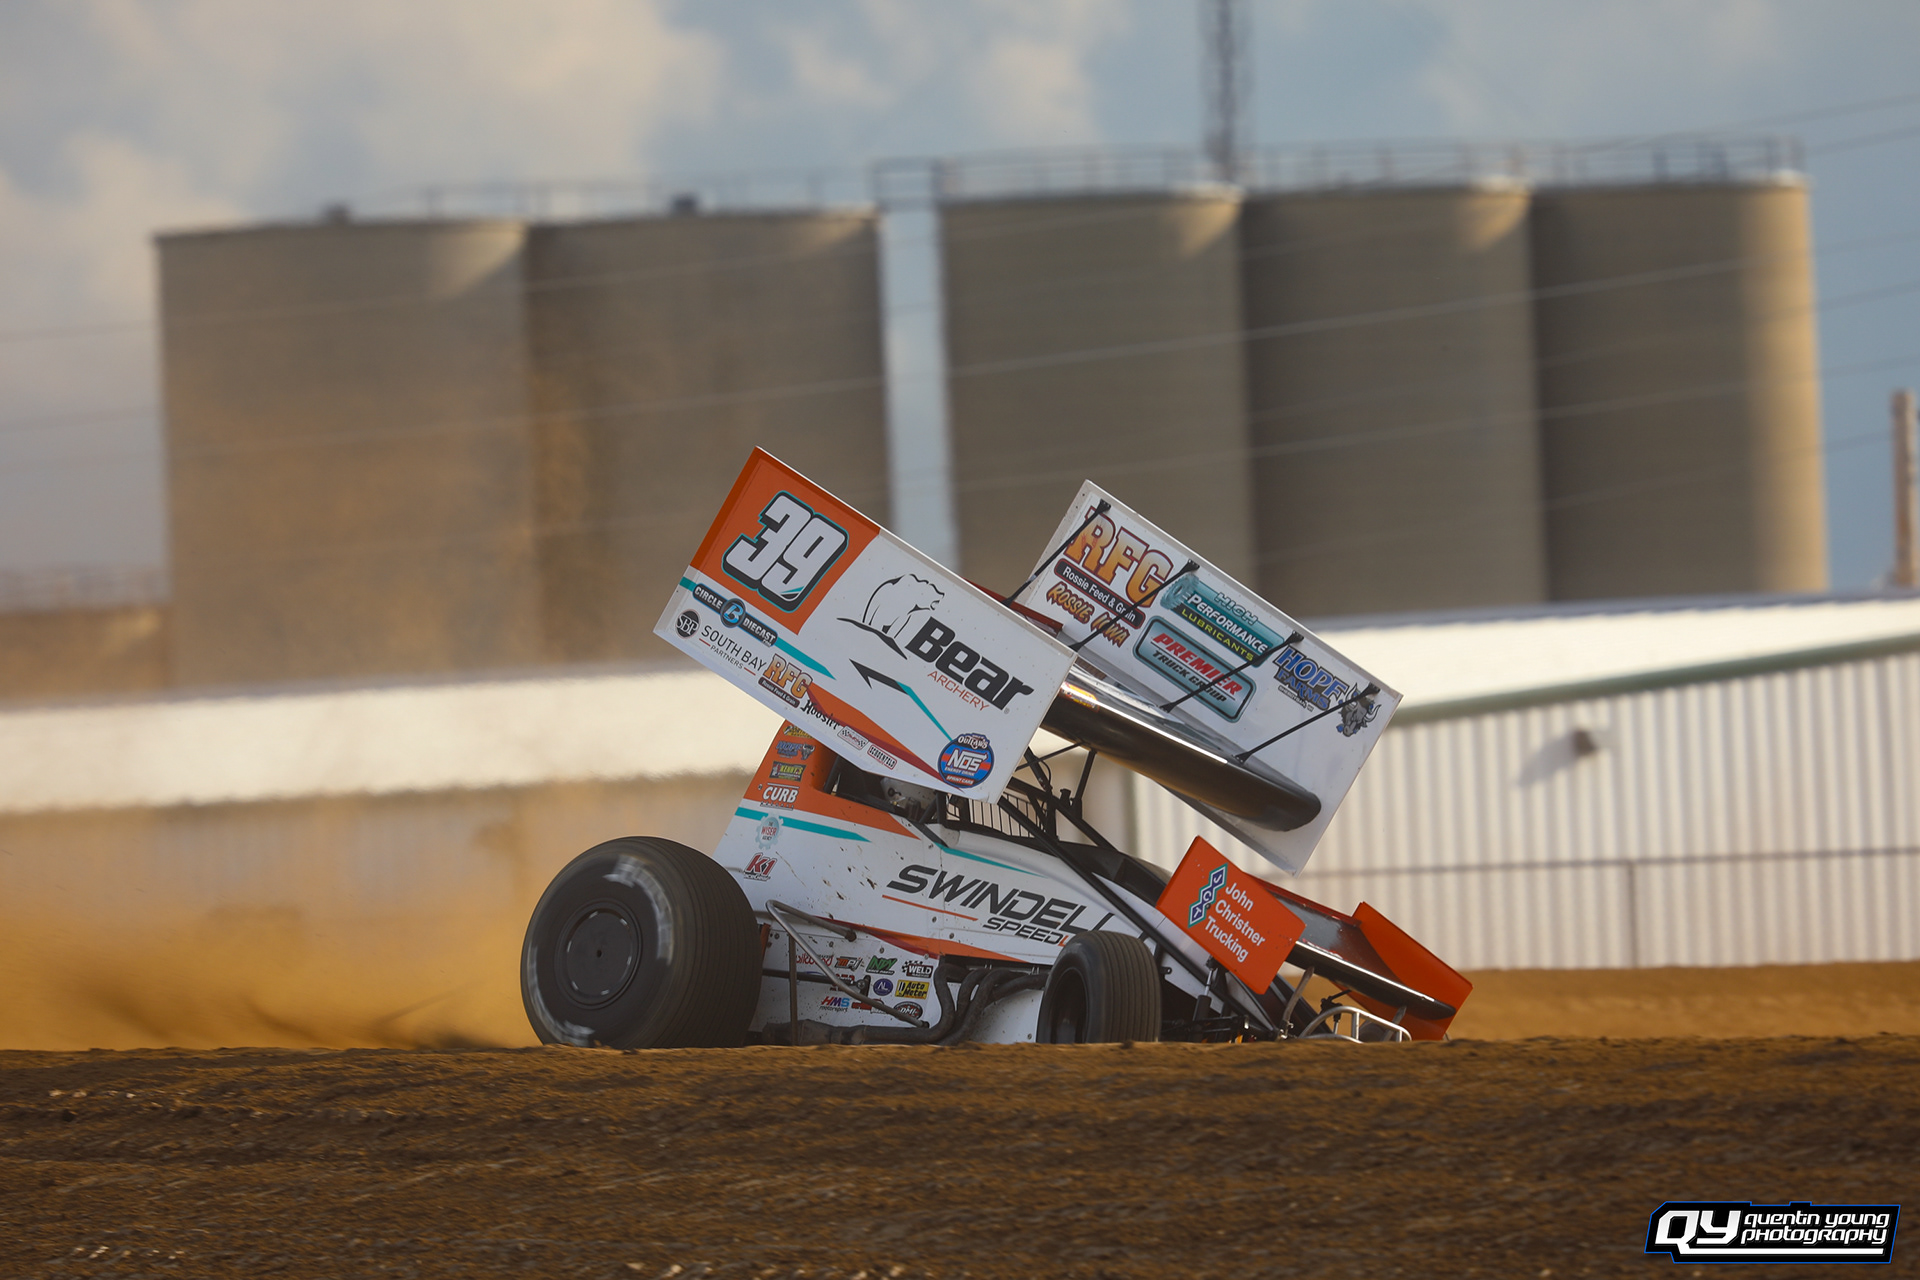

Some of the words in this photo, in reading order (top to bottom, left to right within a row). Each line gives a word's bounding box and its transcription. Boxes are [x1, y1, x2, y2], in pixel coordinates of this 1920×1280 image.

[722, 491, 848, 611] 39
[1063, 505, 1174, 608] RFG
[694, 586, 723, 609] CIRCLE
[1062, 566, 1089, 590] Rossie
[1088, 584, 1109, 603] Feed
[1108, 598, 1115, 609] &
[676, 614, 699, 636] SBP
[1186, 595, 1268, 655] PERFORMANCE
[1215, 592, 1259, 626] HIGH
[743, 618, 776, 643] DIECAST
[1182, 609, 1254, 661] LUBRICANTS
[701, 625, 742, 654] SOUTH
[741, 650, 767, 671] BAY
[710, 645, 744, 669] PARTNERS
[904, 616, 1034, 711] Bear
[1152, 650, 1191, 678] TRUCK
[763, 653, 813, 699] RFG
[1152, 633, 1243, 696] PREMIER
[1273, 645, 1349, 701] HOPF
[927, 670, 990, 711] ARCHERY
[1276, 670, 1330, 710] FARMS
[800, 699, 840, 730] Hoosier
[946, 748, 988, 772] NOS
[762, 786, 799, 803] CURB
[761, 826, 777, 836] WISER
[745, 852, 777, 877] K1
[1225, 882, 1254, 911] John
[1205, 915, 1249, 962] Trucking
[1215, 899, 1266, 947] Christner
[867, 955, 898, 971] INDY
[908, 965, 932, 975] WELD
[821, 996, 850, 1007] HMS
[903, 989, 928, 997] Meter
